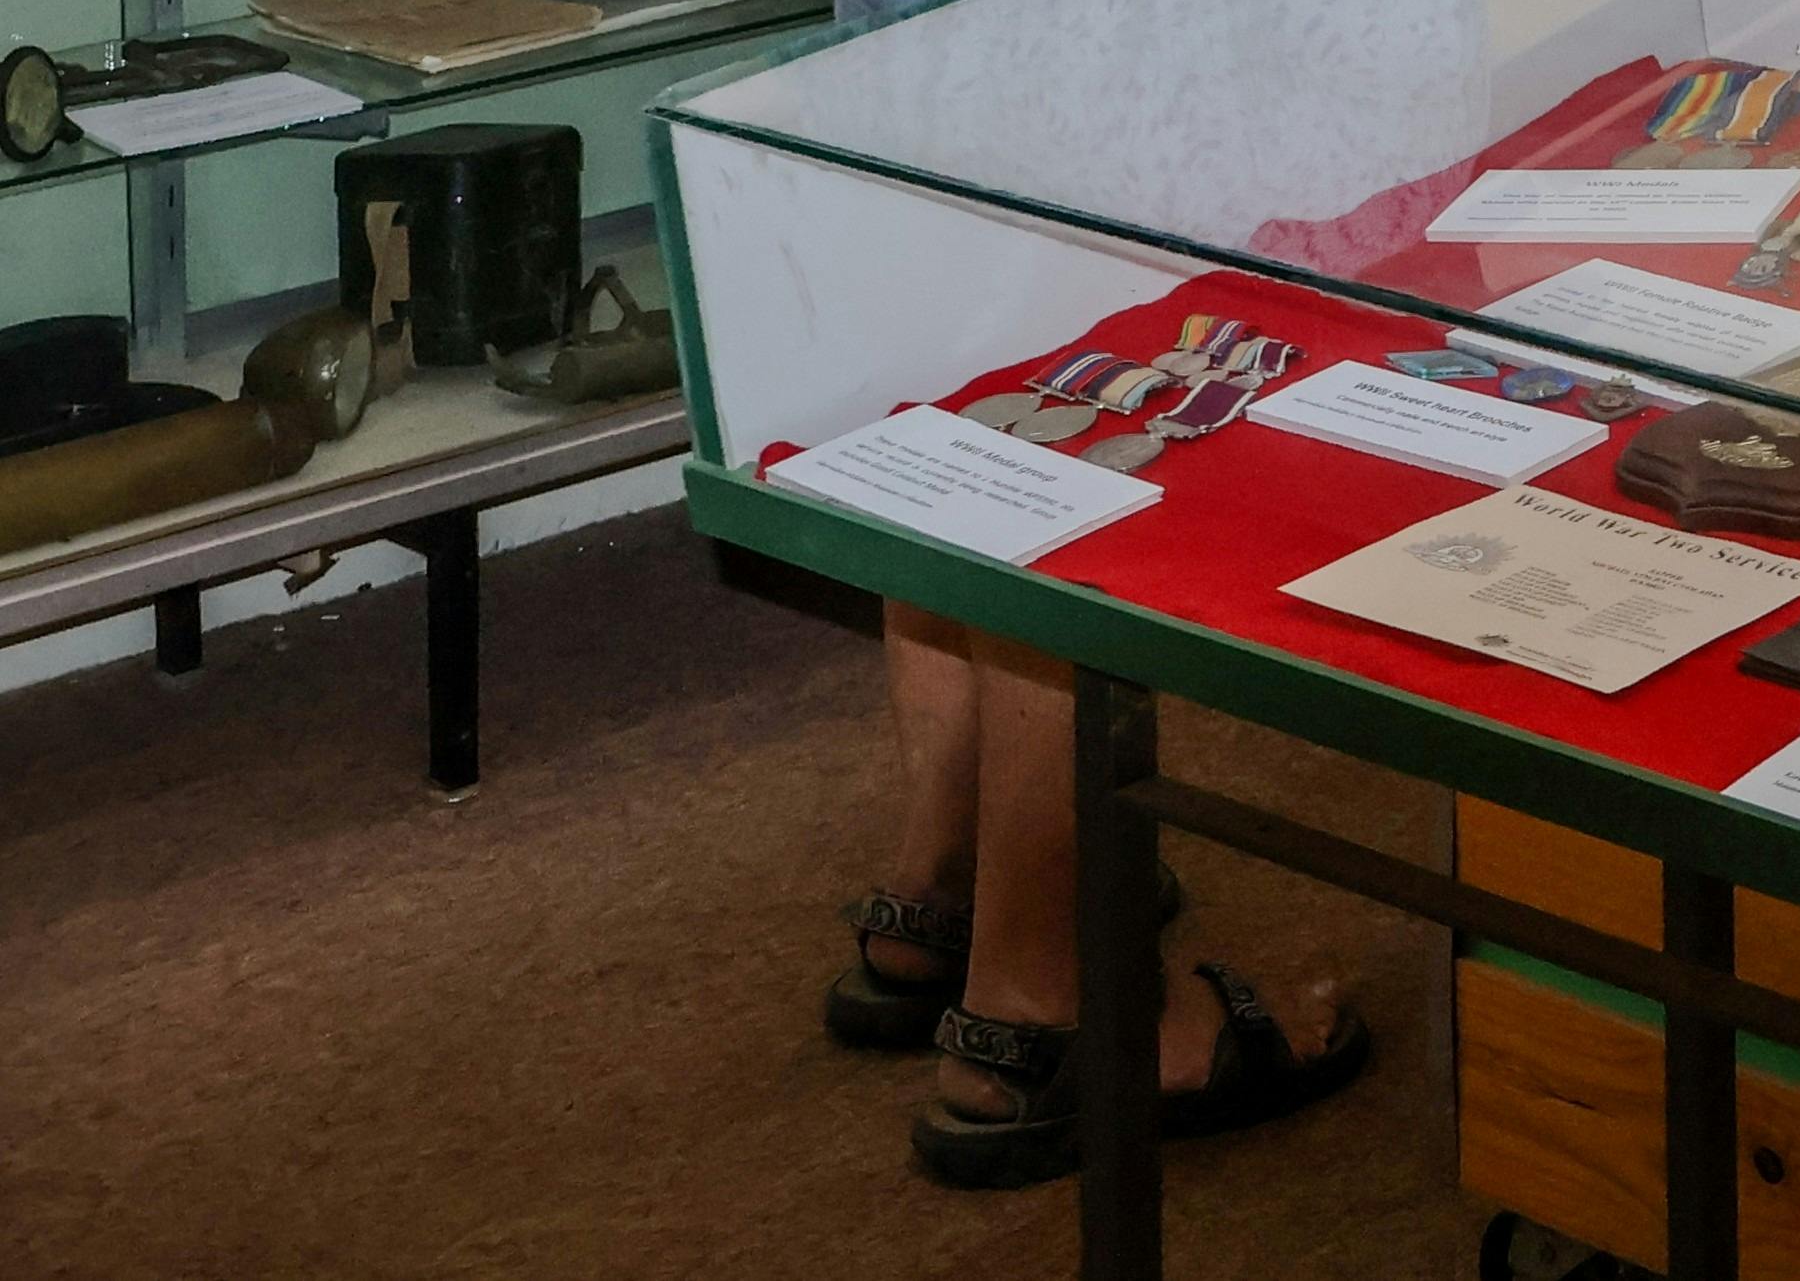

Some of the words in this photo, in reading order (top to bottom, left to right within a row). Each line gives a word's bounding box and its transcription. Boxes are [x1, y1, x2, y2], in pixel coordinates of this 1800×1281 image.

[1353, 382, 1391, 395] WWII
[1388, 391, 1432, 407] Sweet
[1430, 402, 1469, 416] heart
[1466, 411, 1532, 432] Brooches
[949, 439, 986, 455] WWII
[981, 449, 1023, 473] Medal
[1015, 463, 1057, 482] group
[1514, 494, 1591, 522] World
[1596, 518, 1647, 537] War
[1653, 532, 1703, 553] Two
